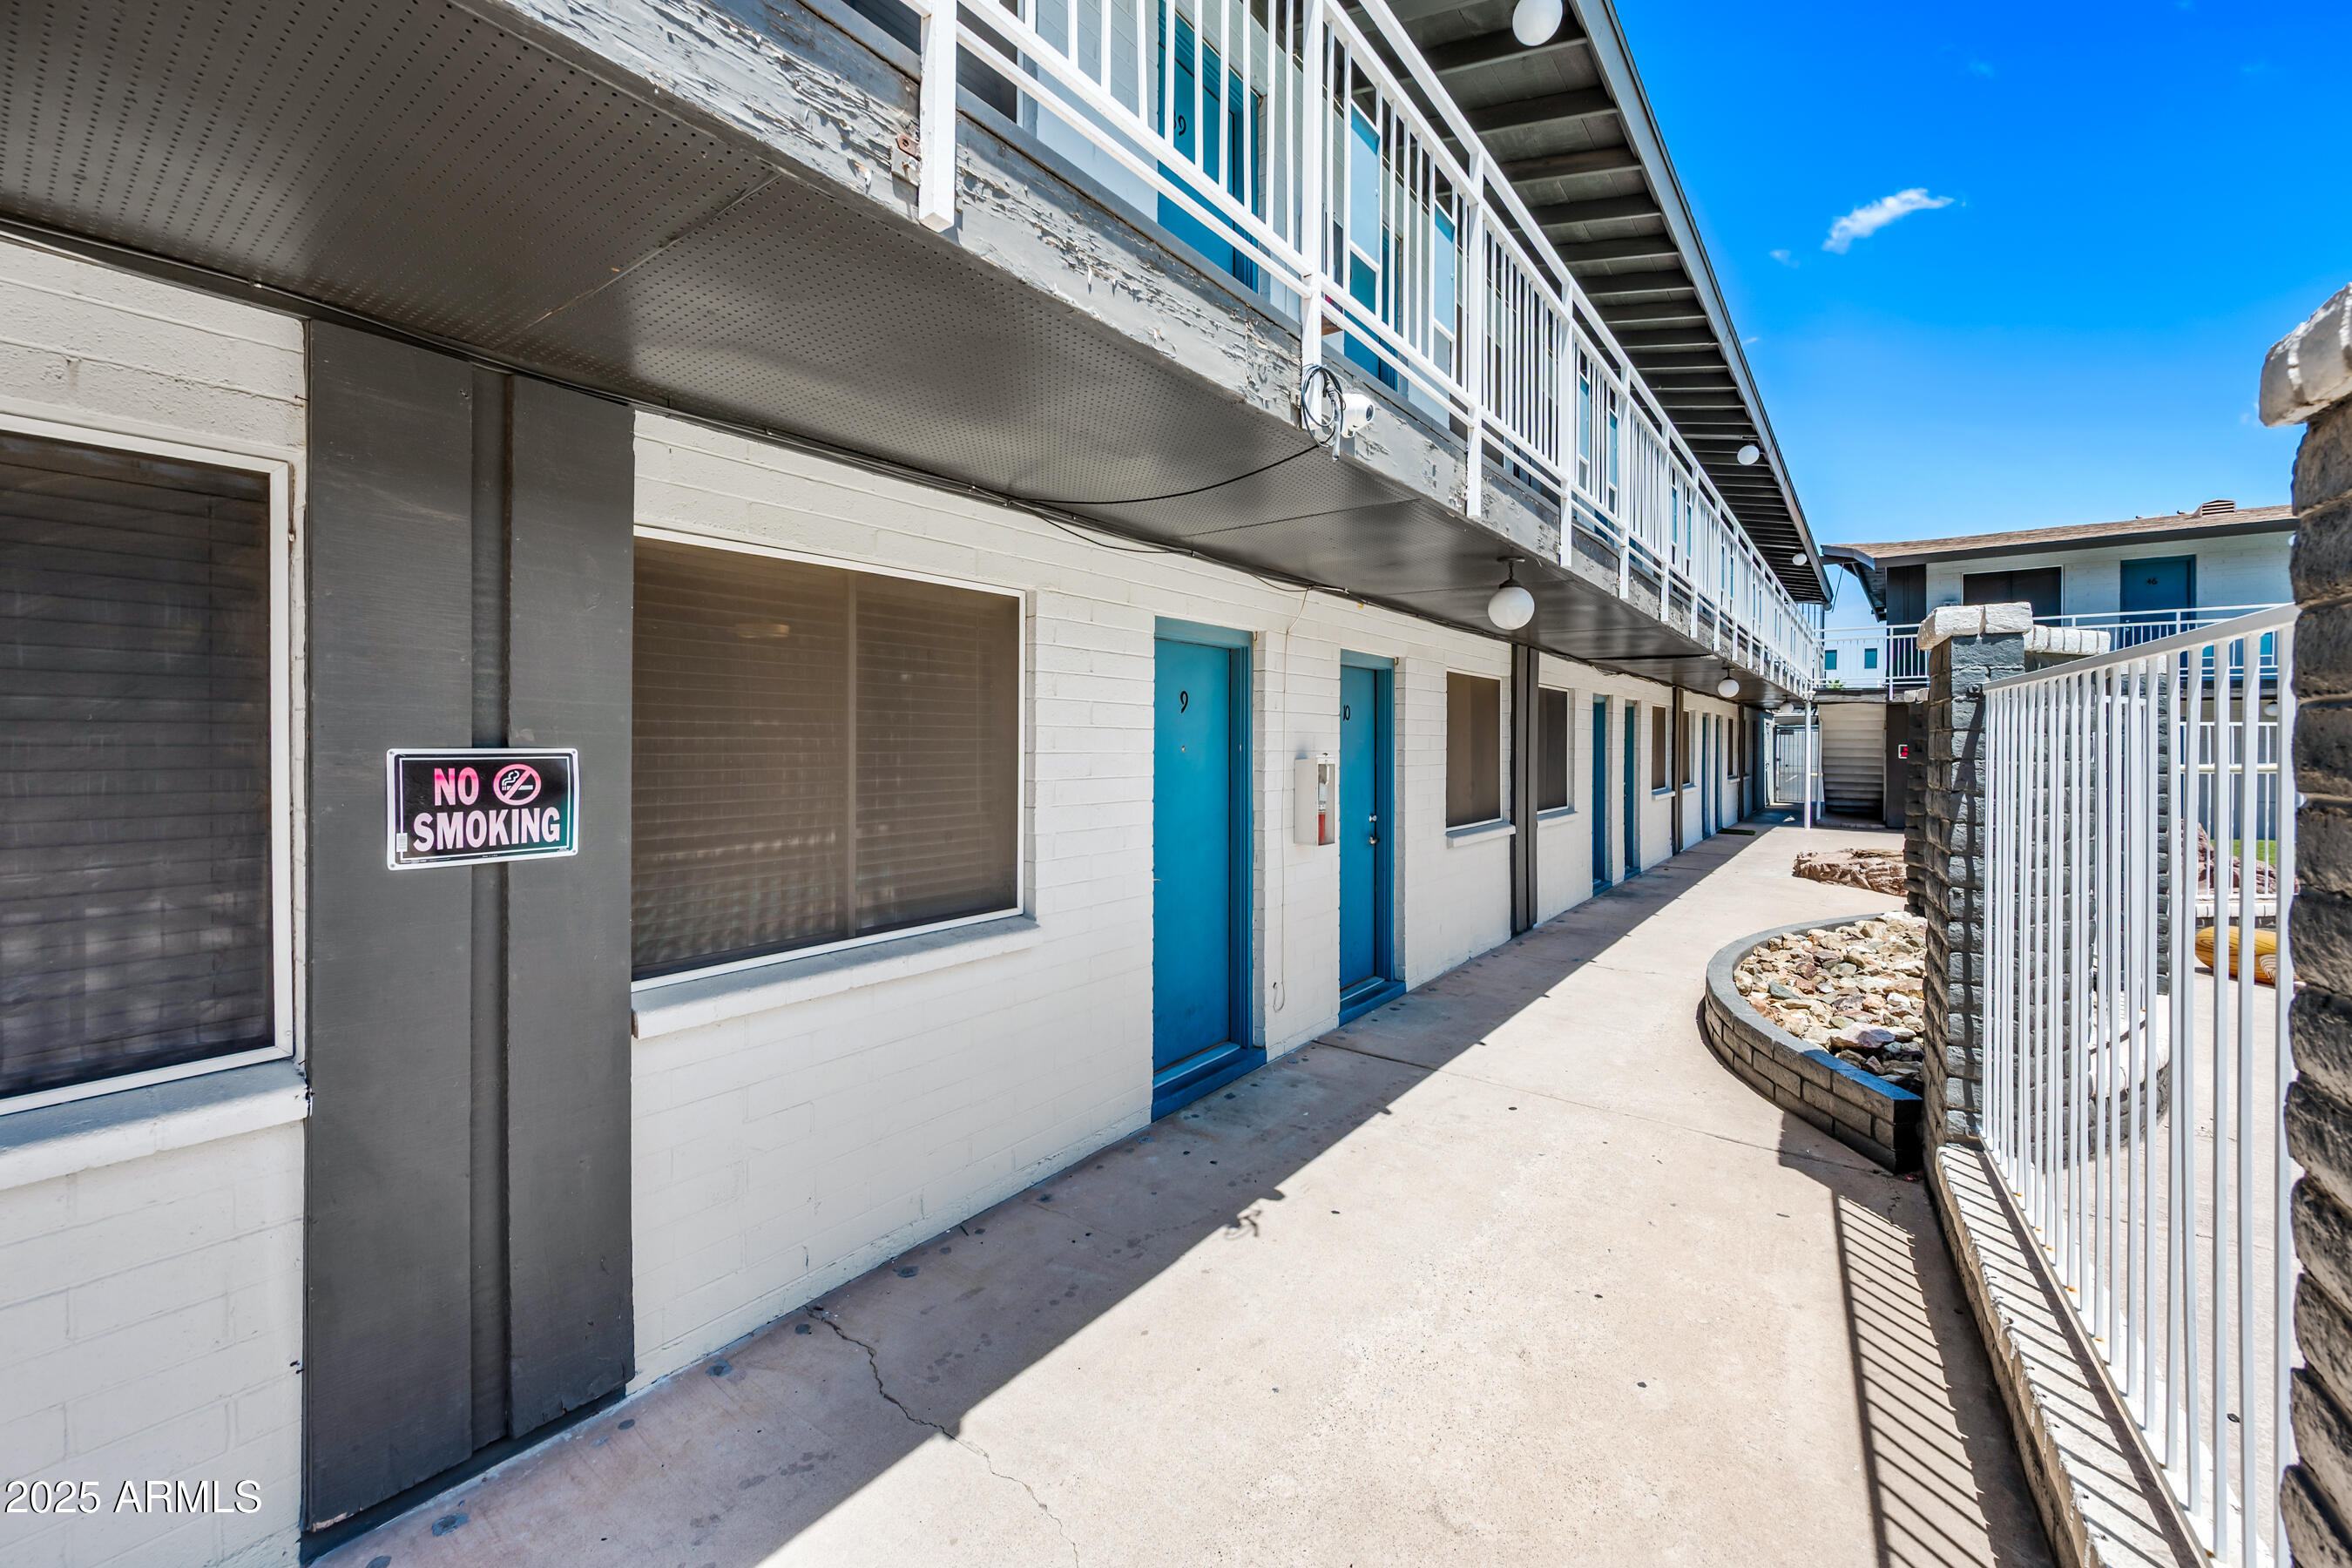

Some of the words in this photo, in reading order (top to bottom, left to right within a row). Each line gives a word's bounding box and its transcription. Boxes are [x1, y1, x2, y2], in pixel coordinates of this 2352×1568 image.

[1173, 112, 1186, 137] 9
[1179, 690, 1189, 714] 9
[1342, 704, 1351, 722] 10
[434, 767, 479, 807] NO
[413, 807, 560, 852] SMOKING
